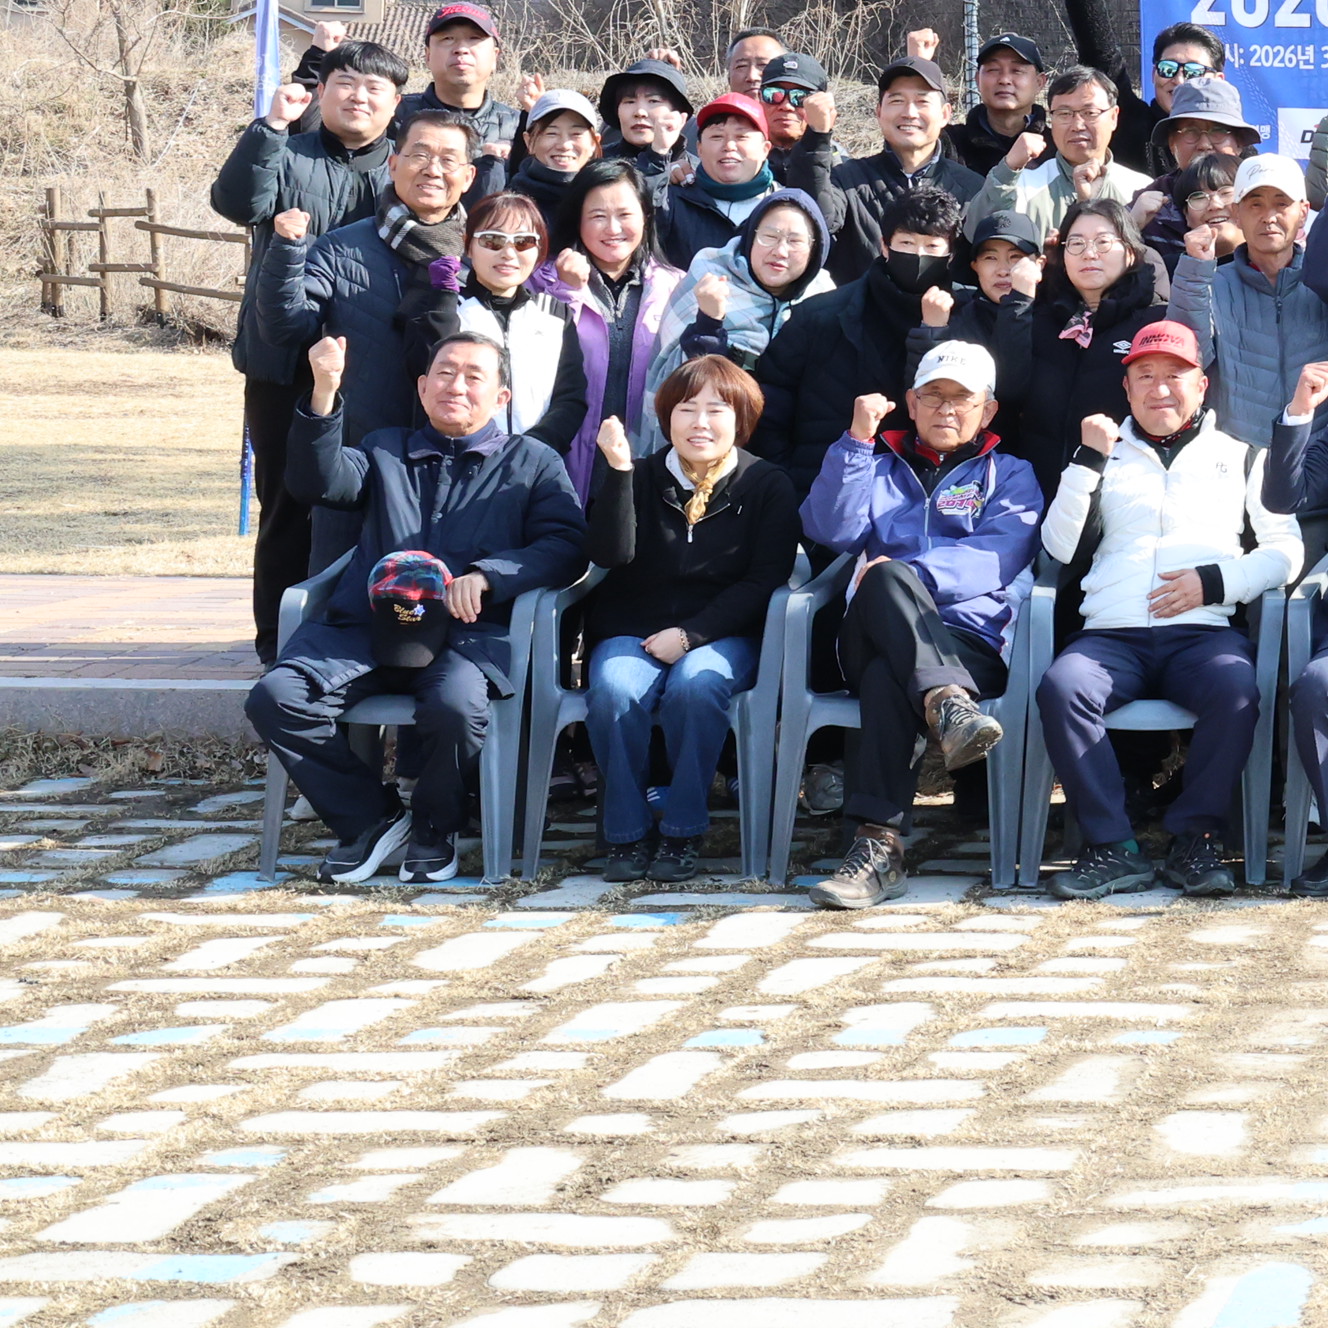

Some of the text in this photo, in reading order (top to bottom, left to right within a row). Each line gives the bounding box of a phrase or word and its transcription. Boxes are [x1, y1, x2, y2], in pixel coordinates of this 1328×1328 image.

[1225, 43, 1245, 68] 시:
[1249, 44, 1315, 70] 2026년
[937, 354, 967, 366] NIKE
[393, 603, 415, 616] Blue
